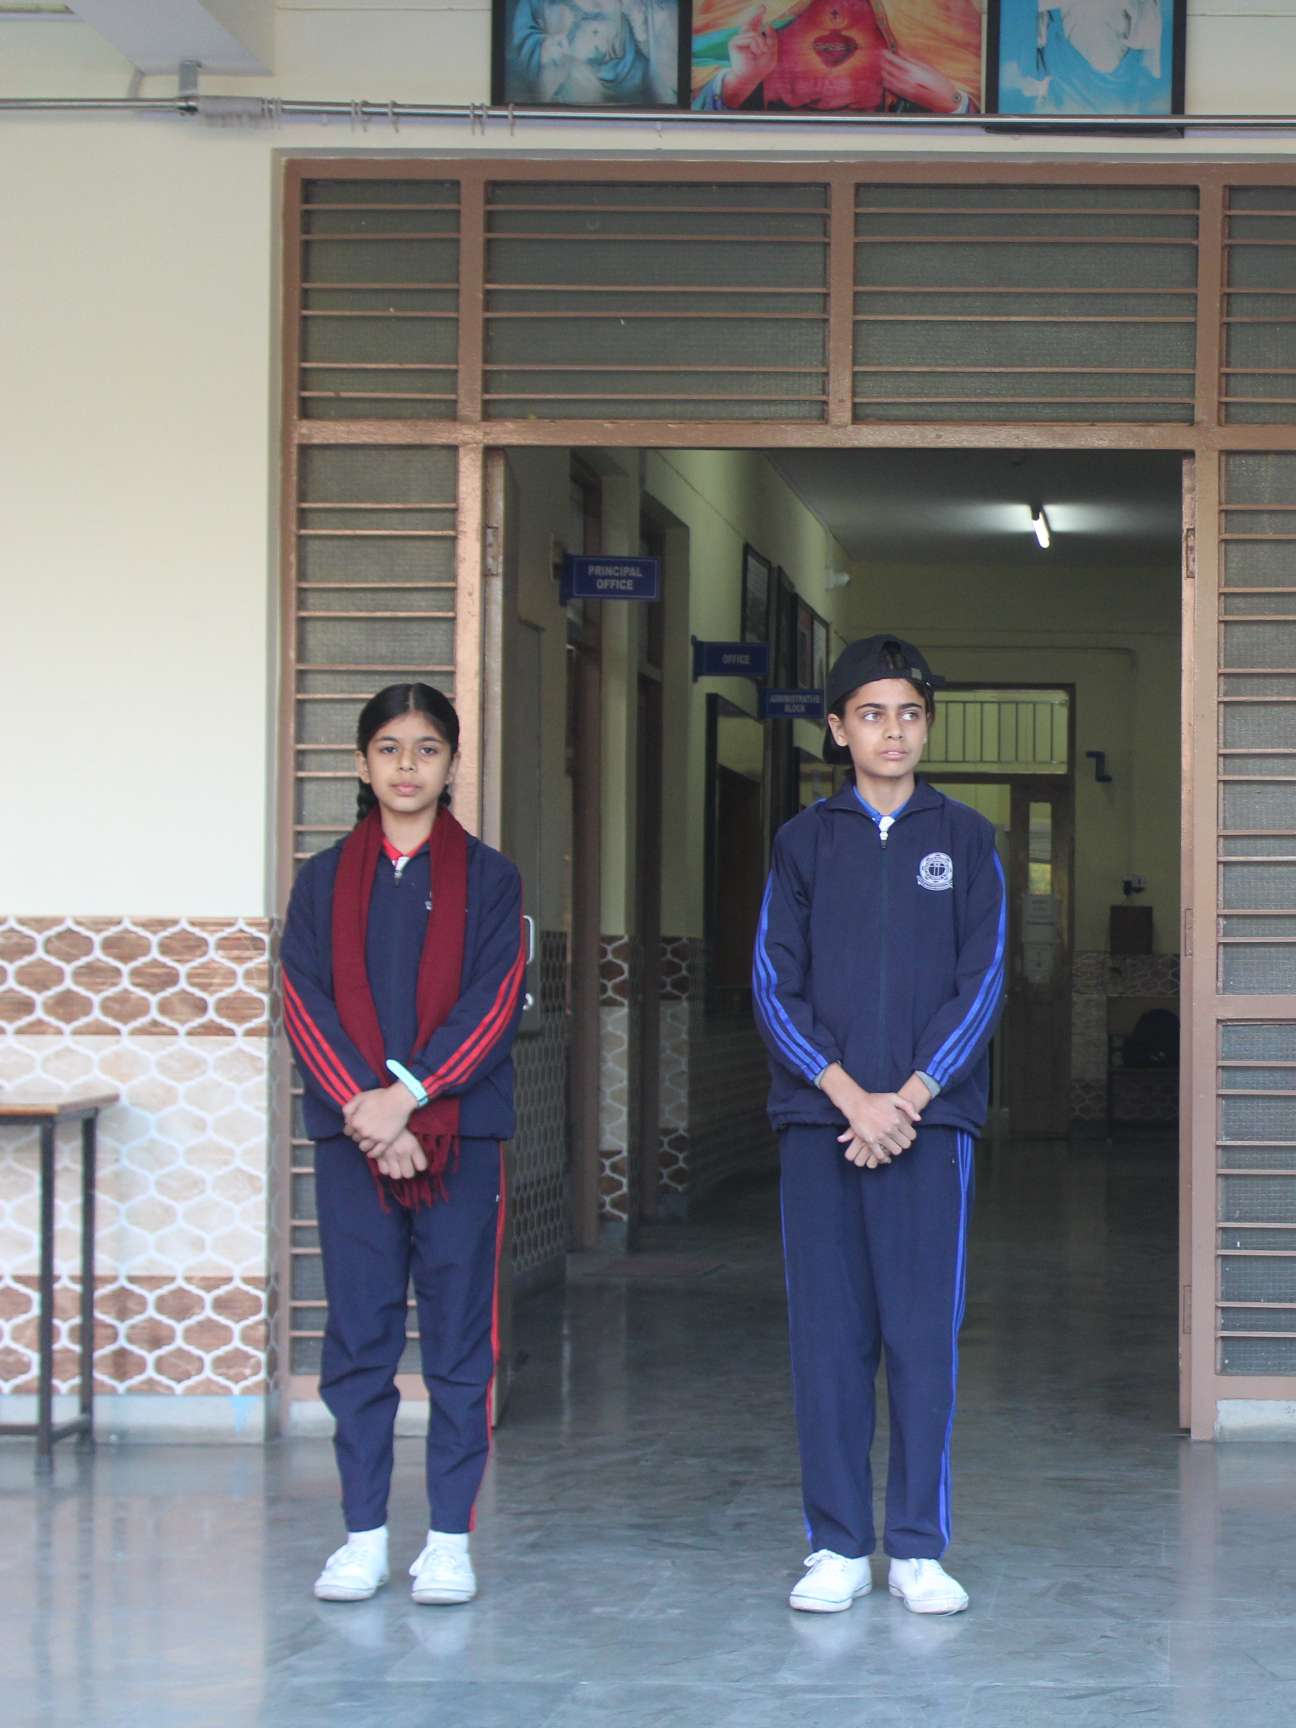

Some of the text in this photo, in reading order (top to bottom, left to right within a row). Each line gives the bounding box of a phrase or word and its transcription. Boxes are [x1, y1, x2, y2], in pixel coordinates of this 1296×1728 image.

[587, 565, 642, 576] PRINCIPAL
[596, 579, 634, 590] OFFICE
[721, 654, 750, 664] OFFICE
